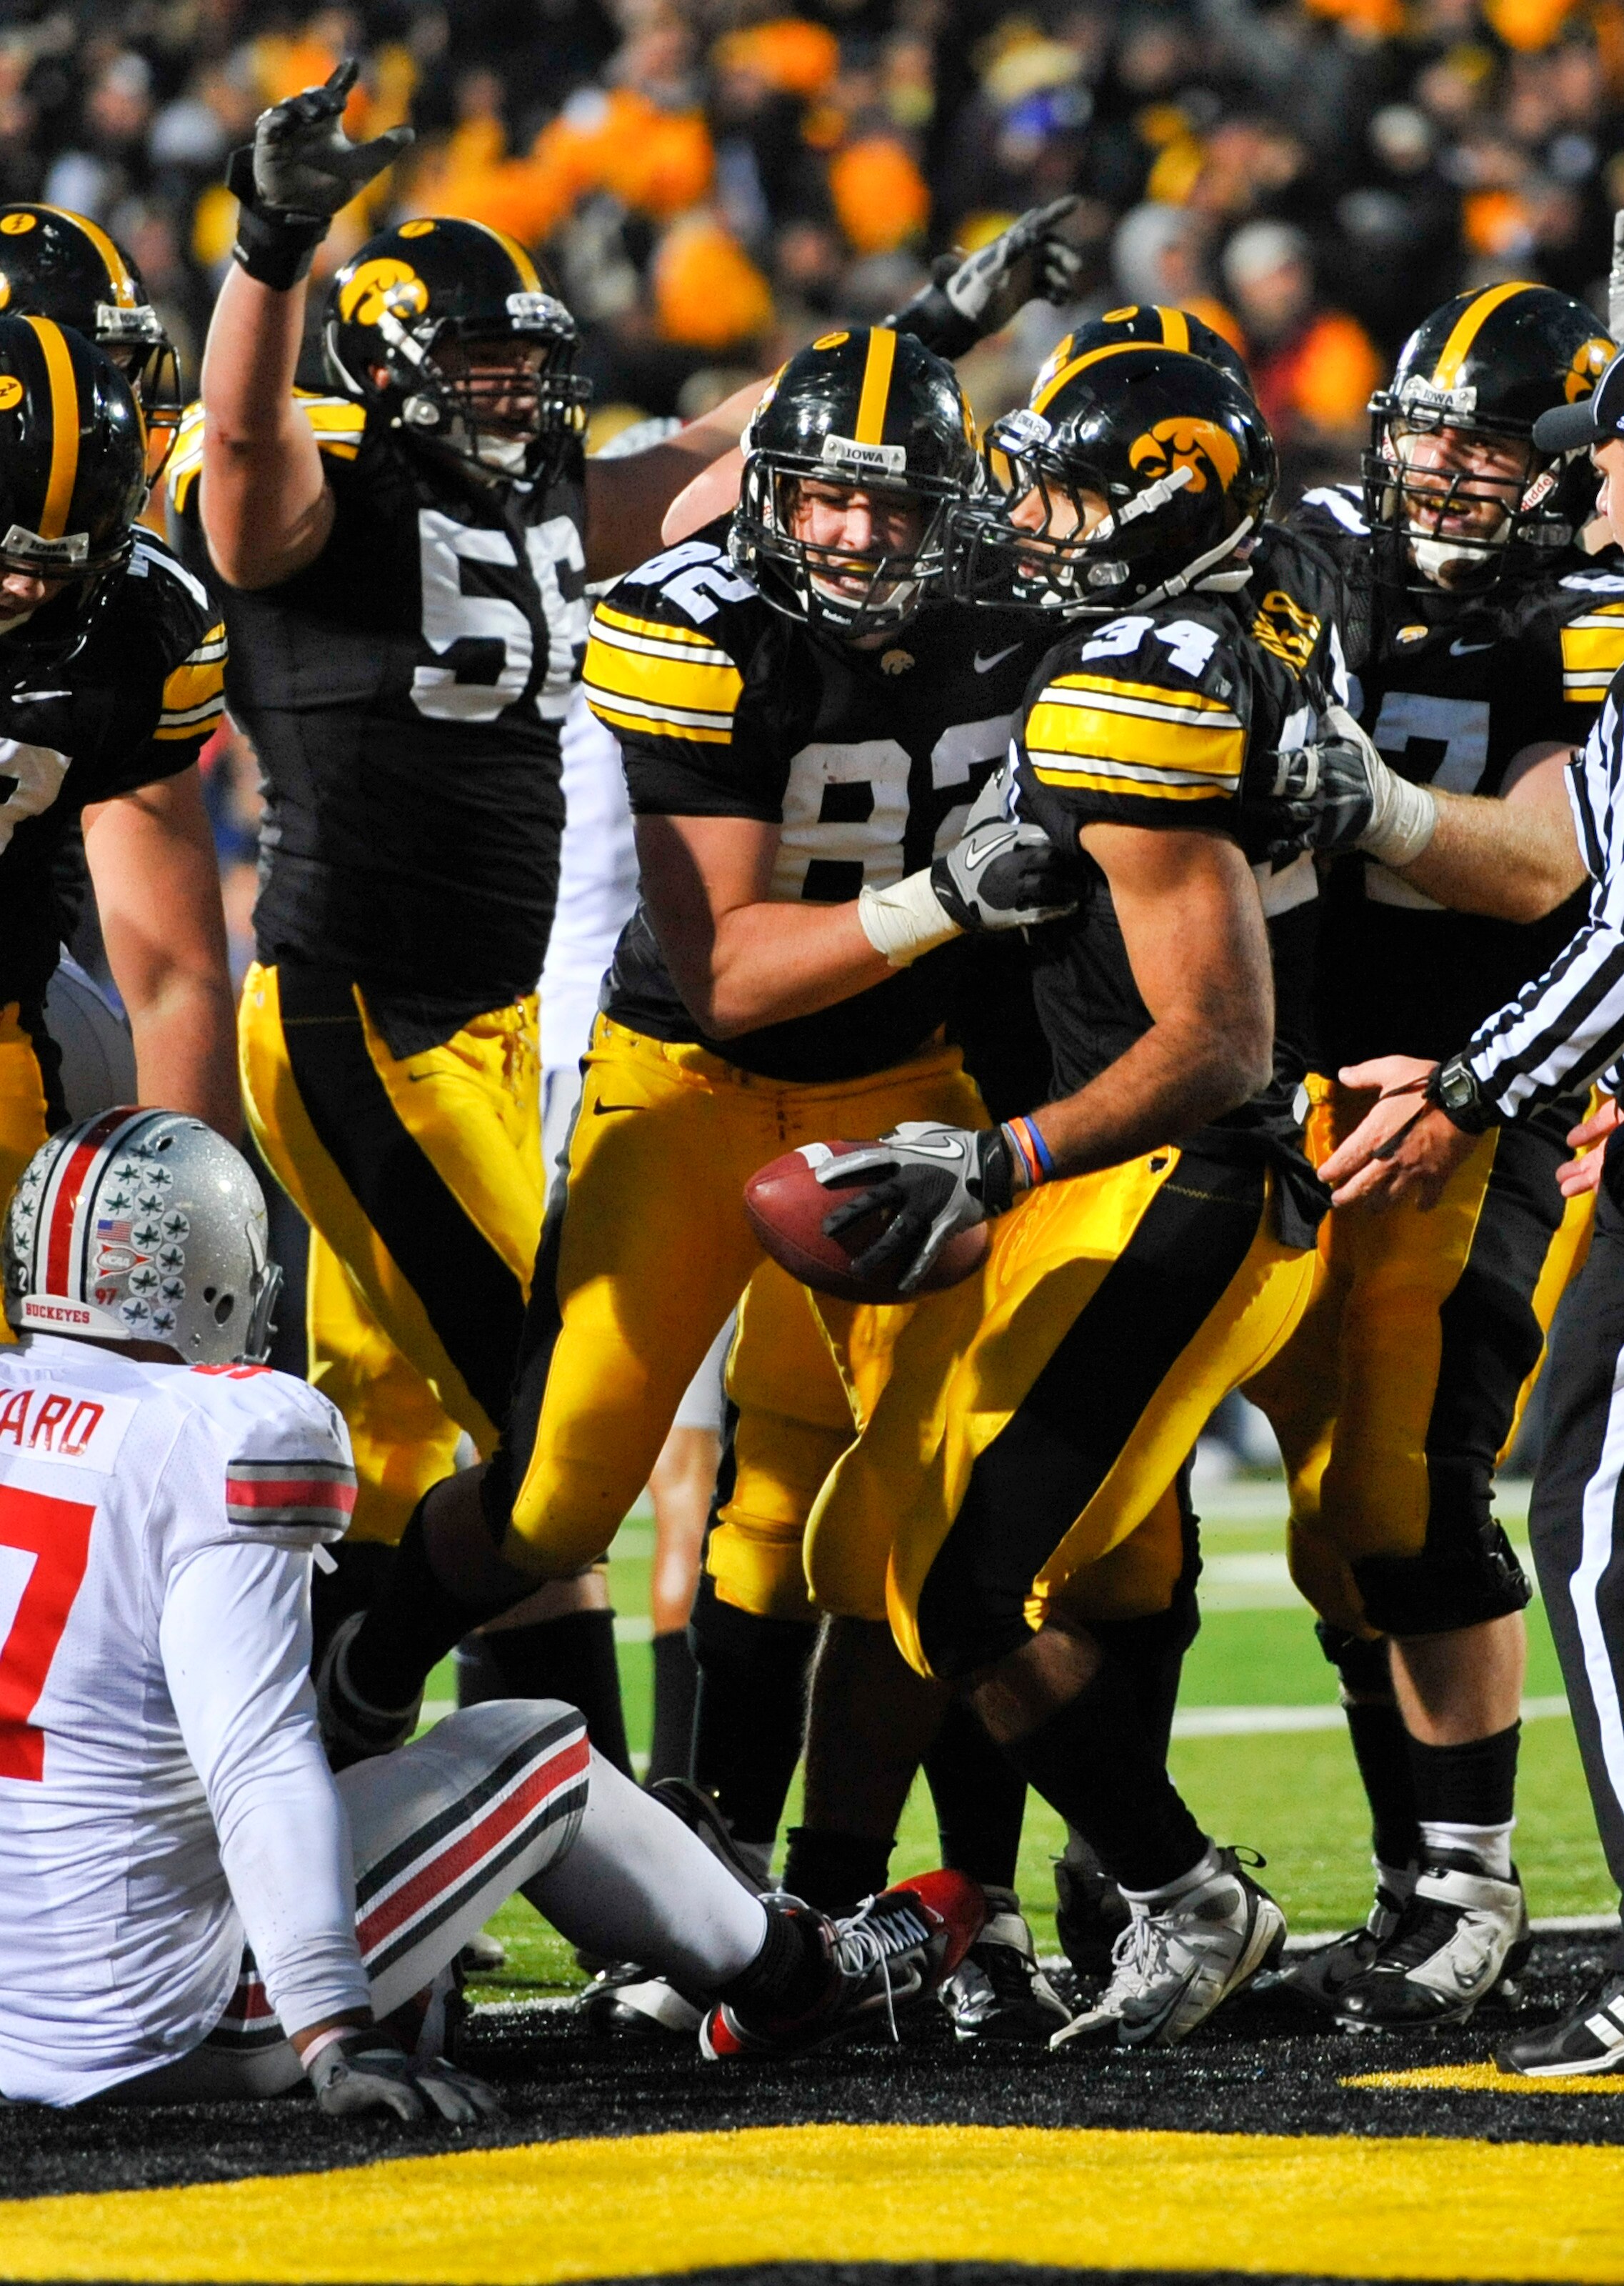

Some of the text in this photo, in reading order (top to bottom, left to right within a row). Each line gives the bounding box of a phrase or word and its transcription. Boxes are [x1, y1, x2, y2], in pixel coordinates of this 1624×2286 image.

[1423, 389, 1454, 405] IOWA
[846, 448, 884, 464] IOWA
[29, 542, 68, 553] IOWA
[623, 541, 760, 625] 82
[1081, 616, 1220, 678] 34
[100, 1252, 131, 1269] NCAA
[94, 1287, 119, 1305] 97
[25, 1302, 91, 1324] BUCKEYES
[0, 1388, 105, 1457] ARD
